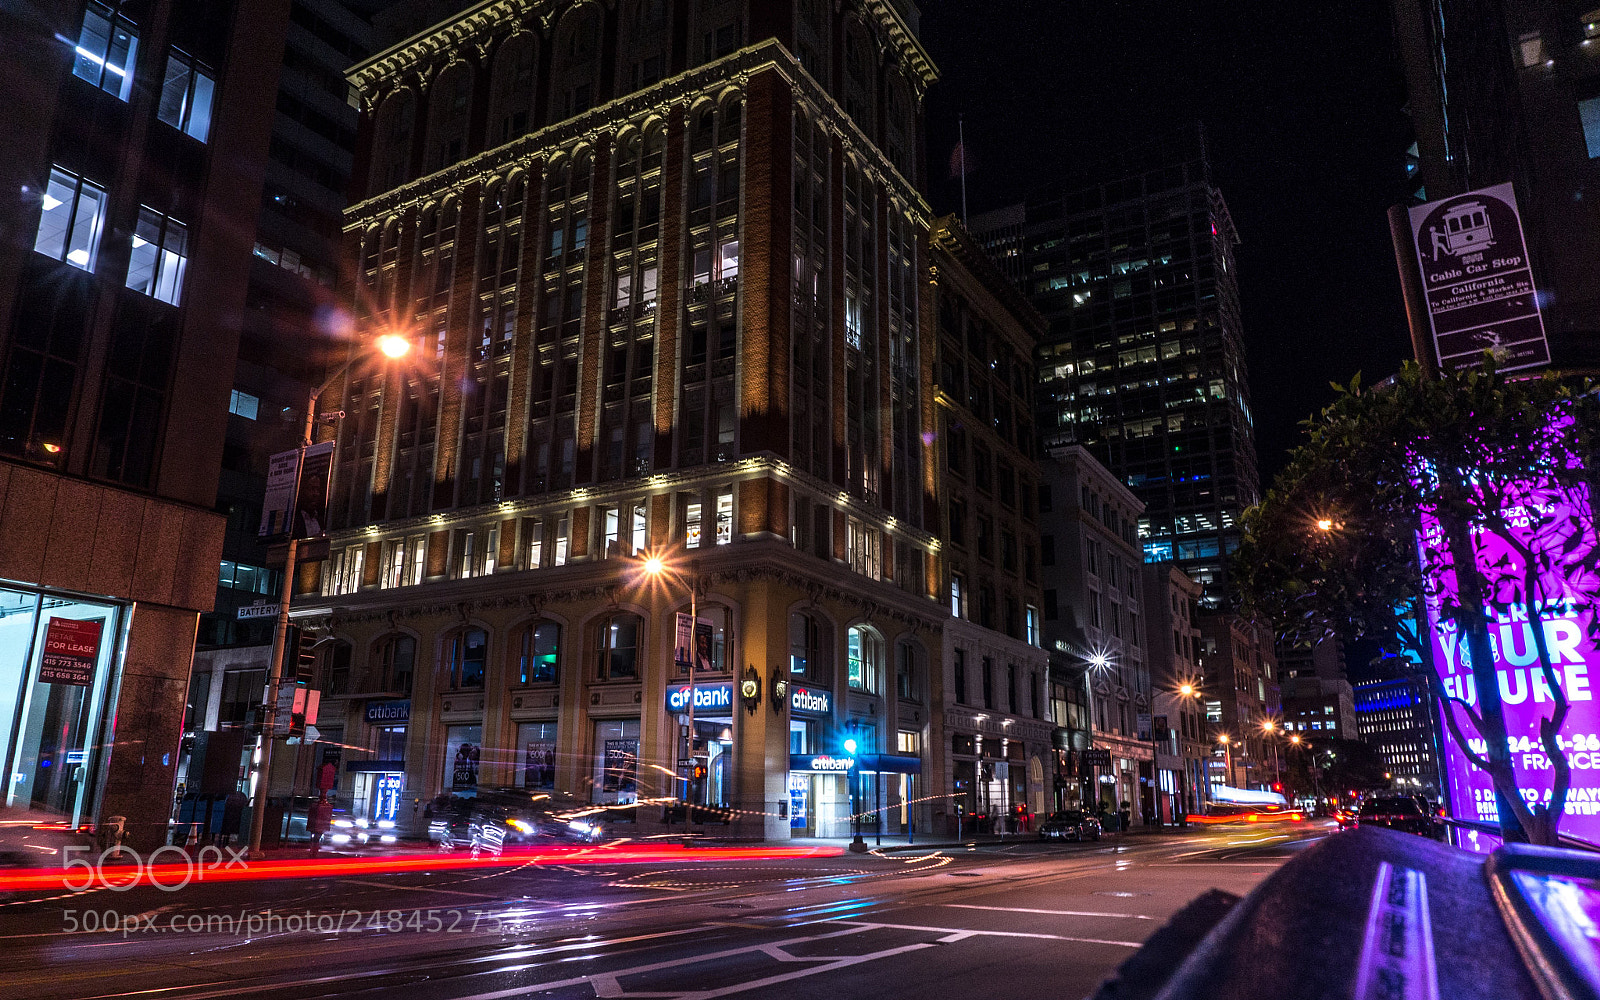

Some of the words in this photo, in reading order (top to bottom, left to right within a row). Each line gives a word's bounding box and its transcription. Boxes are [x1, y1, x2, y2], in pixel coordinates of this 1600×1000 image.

[1430, 268, 1463, 283] Cable
[1466, 263, 1488, 275] Car
[1492, 255, 1521, 269] Stop
[1451, 277, 1505, 296] California
[240, 605, 278, 617] BATTERY
[49, 632, 76, 642] RETAIL
[47, 641, 66, 650] FOR
[67, 643, 95, 654] LEASE
[1438, 619, 1586, 675] YUR
[44, 658, 57, 666] 415
[41, 670, 55, 678] 415
[1443, 664, 1593, 708] FUURE
[670, 685, 730, 707] citbank
[793, 688, 829, 712] citibank
[369, 703, 409, 719] citibank
[812, 756, 855, 770] citibank
